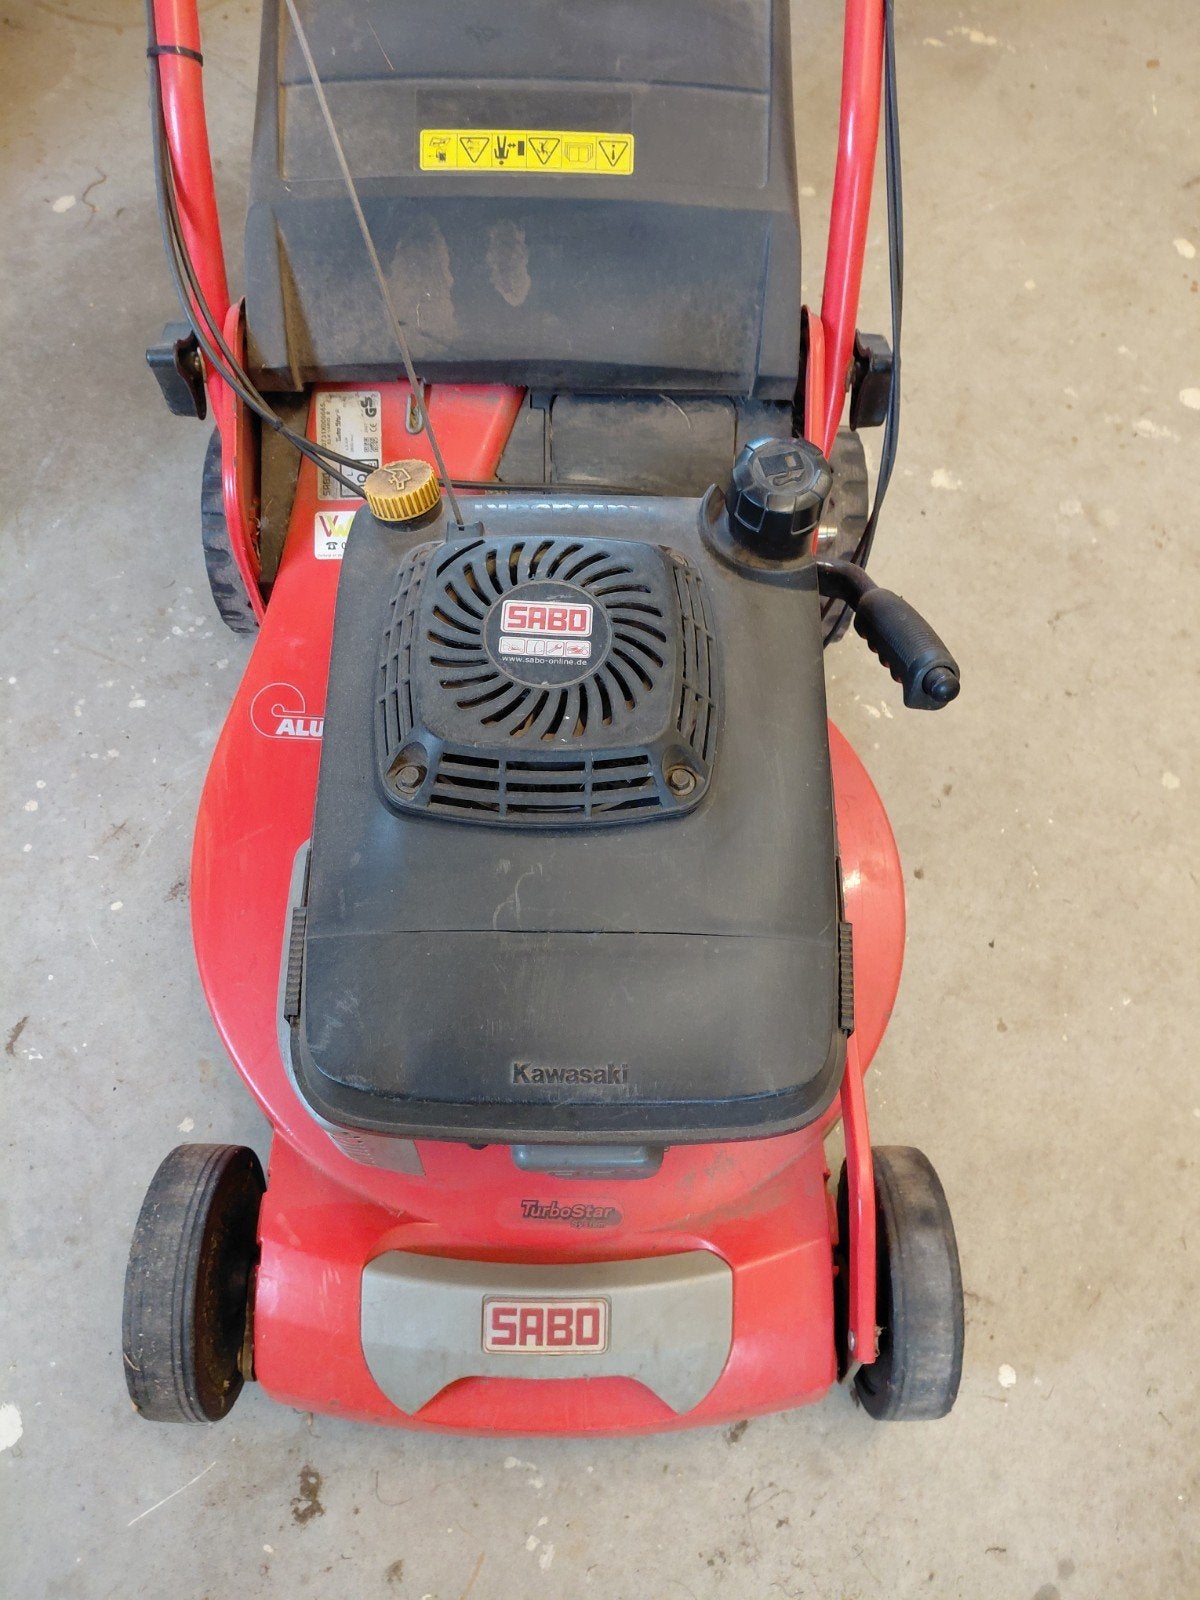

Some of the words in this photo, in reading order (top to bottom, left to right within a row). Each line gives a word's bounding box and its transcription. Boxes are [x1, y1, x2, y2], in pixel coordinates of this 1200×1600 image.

[507, 605, 587, 631] SABO
[502, 656, 588, 666] www.sabo-online.de
[275, 718, 324, 737] ALU
[511, 1061, 628, 1084] Kawasaki
[521, 1200, 616, 1219] TurboStar
[491, 1307, 600, 1346] SABO
